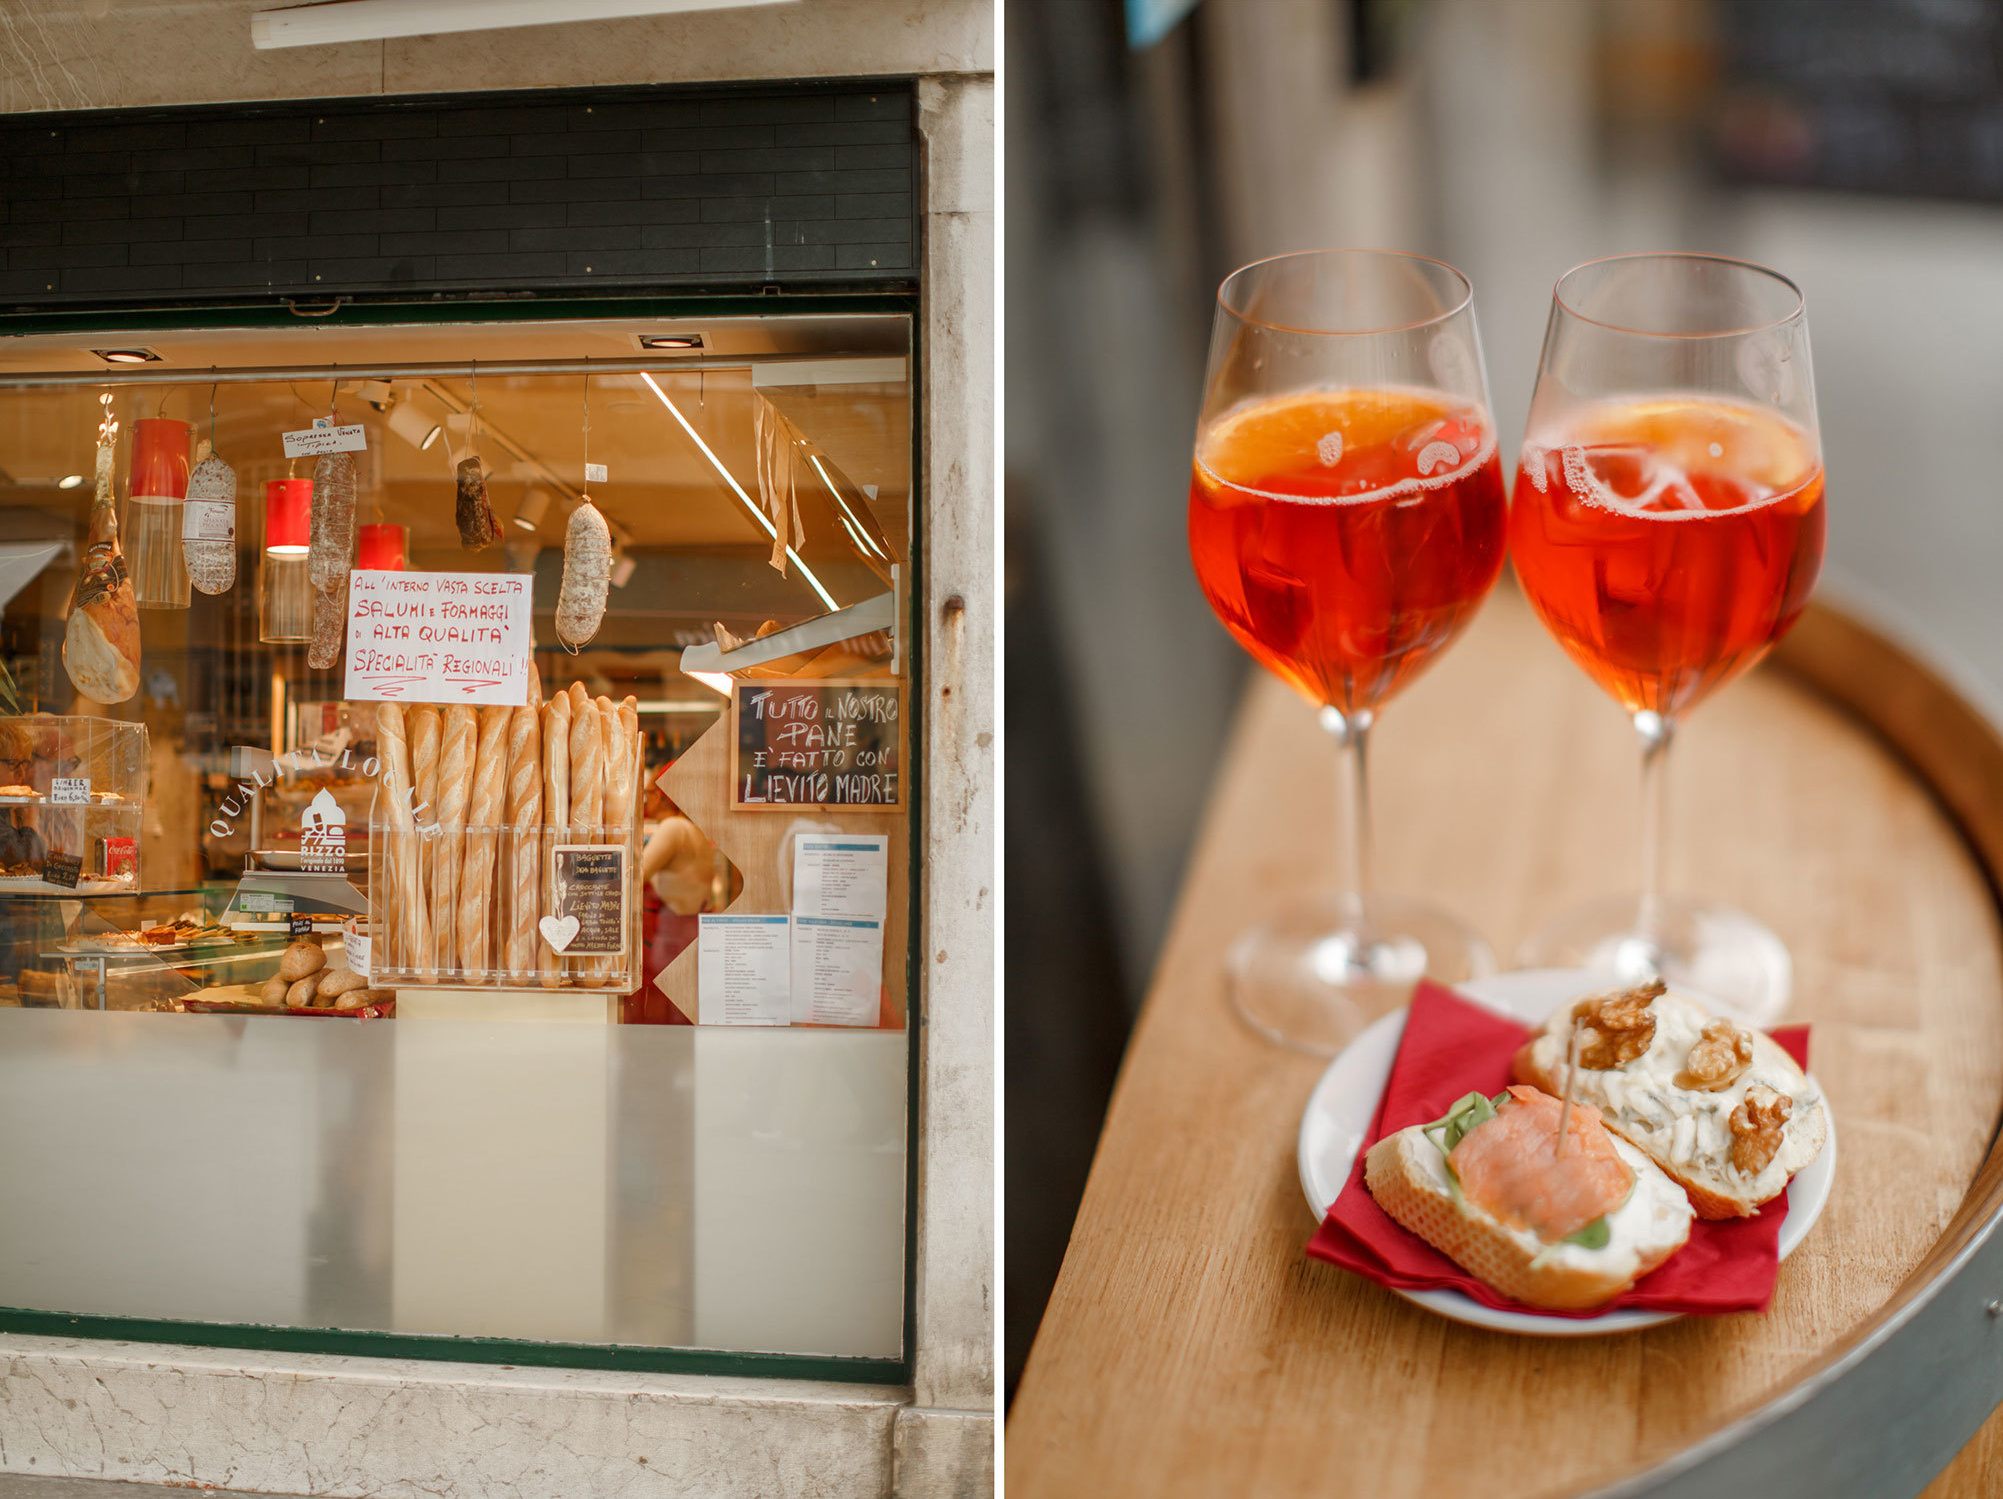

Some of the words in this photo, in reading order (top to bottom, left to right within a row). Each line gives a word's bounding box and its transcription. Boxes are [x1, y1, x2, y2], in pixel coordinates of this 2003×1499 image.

[437, 579, 468, 595] VASTA
[474, 581, 523, 595] SCELTA
[354, 599, 425, 618] SALUMI
[441, 601, 509, 621] FORMAGGI
[374, 624, 410, 640] ALTA
[750, 690, 819, 720] TUTTO
[838, 692, 898, 723] NOSTRO
[776, 722, 857, 747] PANE
[778, 749, 845, 768] FATTO
[856, 747, 890, 767] CON
[341, 748, 444, 842] LOCALE
[744, 770, 829, 803] LIEVITO
[836, 773, 898, 803] MADRE
[301, 846, 346, 857] RIZZO
